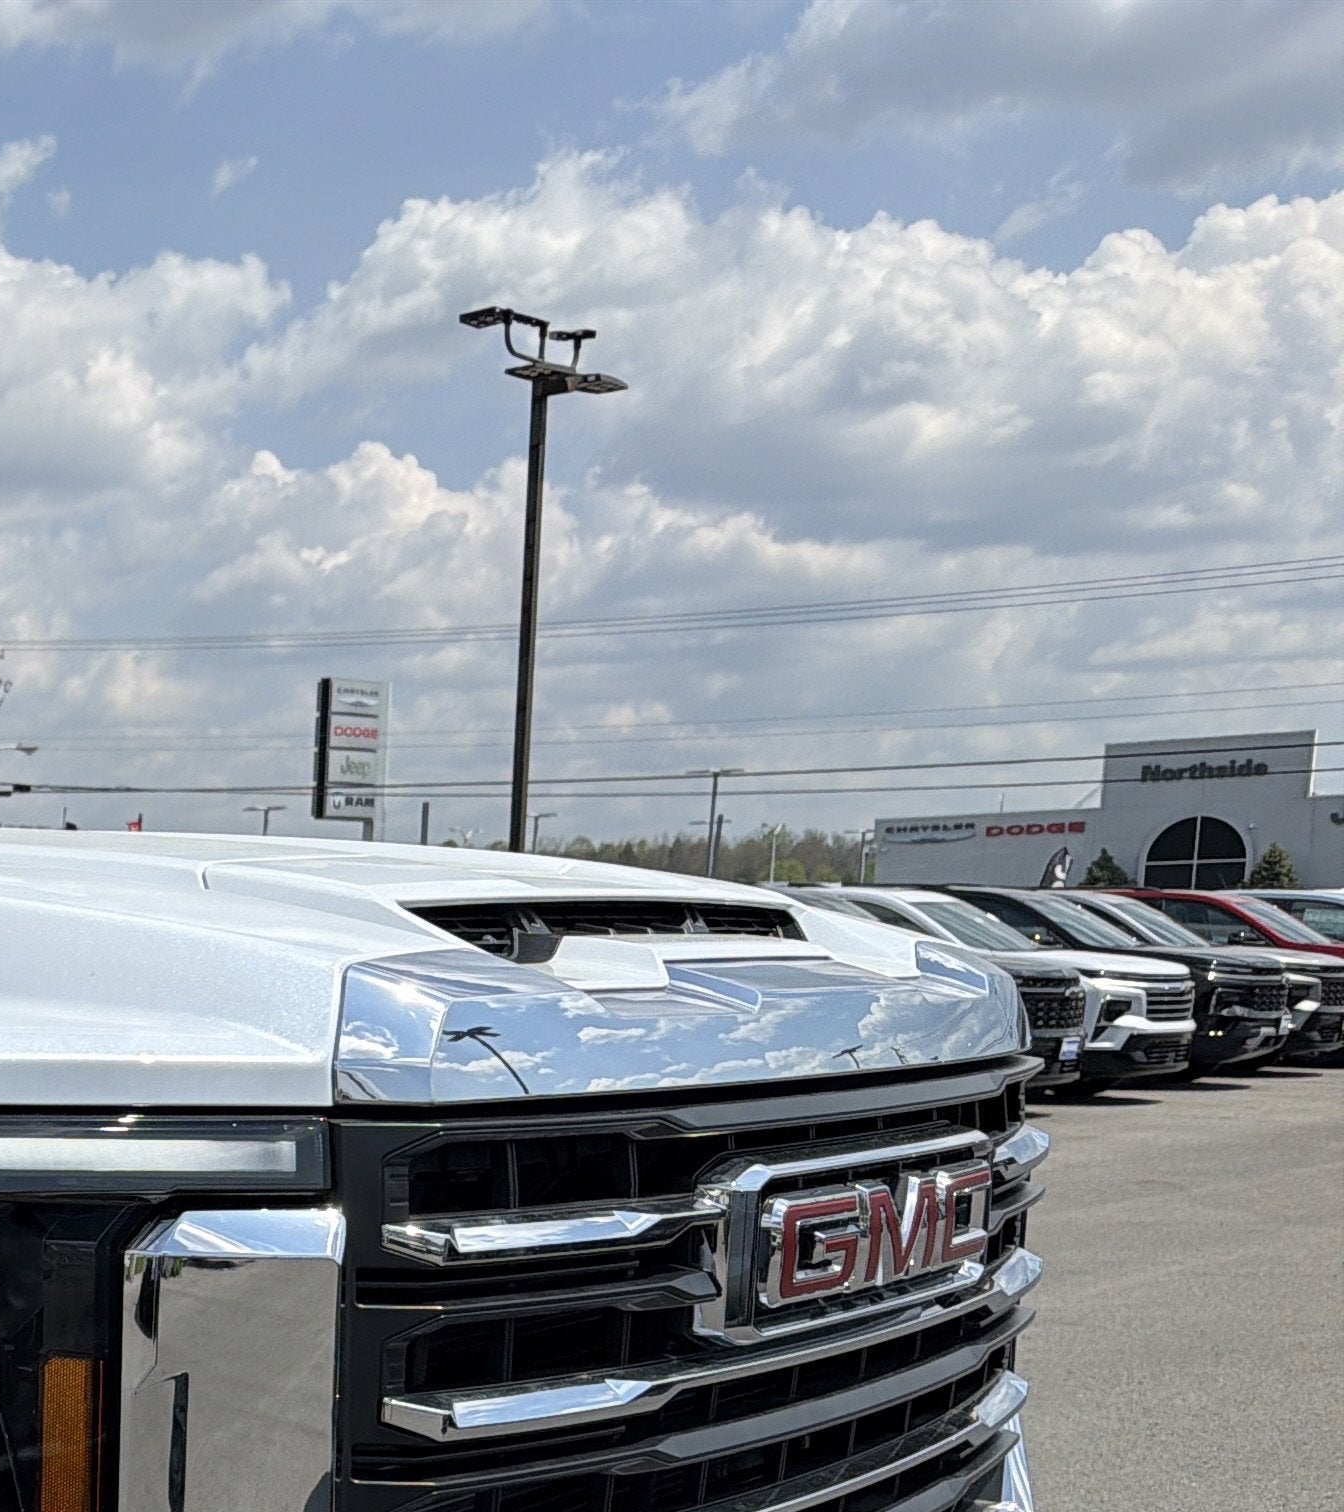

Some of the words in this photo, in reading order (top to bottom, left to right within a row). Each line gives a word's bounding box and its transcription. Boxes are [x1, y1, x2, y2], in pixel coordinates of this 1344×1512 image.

[334, 726, 377, 739] DODGE
[340, 755, 371, 777] Jeep
[1141, 758, 1268, 782] Northside
[344, 795, 375, 808] RAM
[885, 822, 975, 833] CHRYSLER
[985, 821, 1085, 837] DODGE
[758, 1159, 992, 1309] GMC
